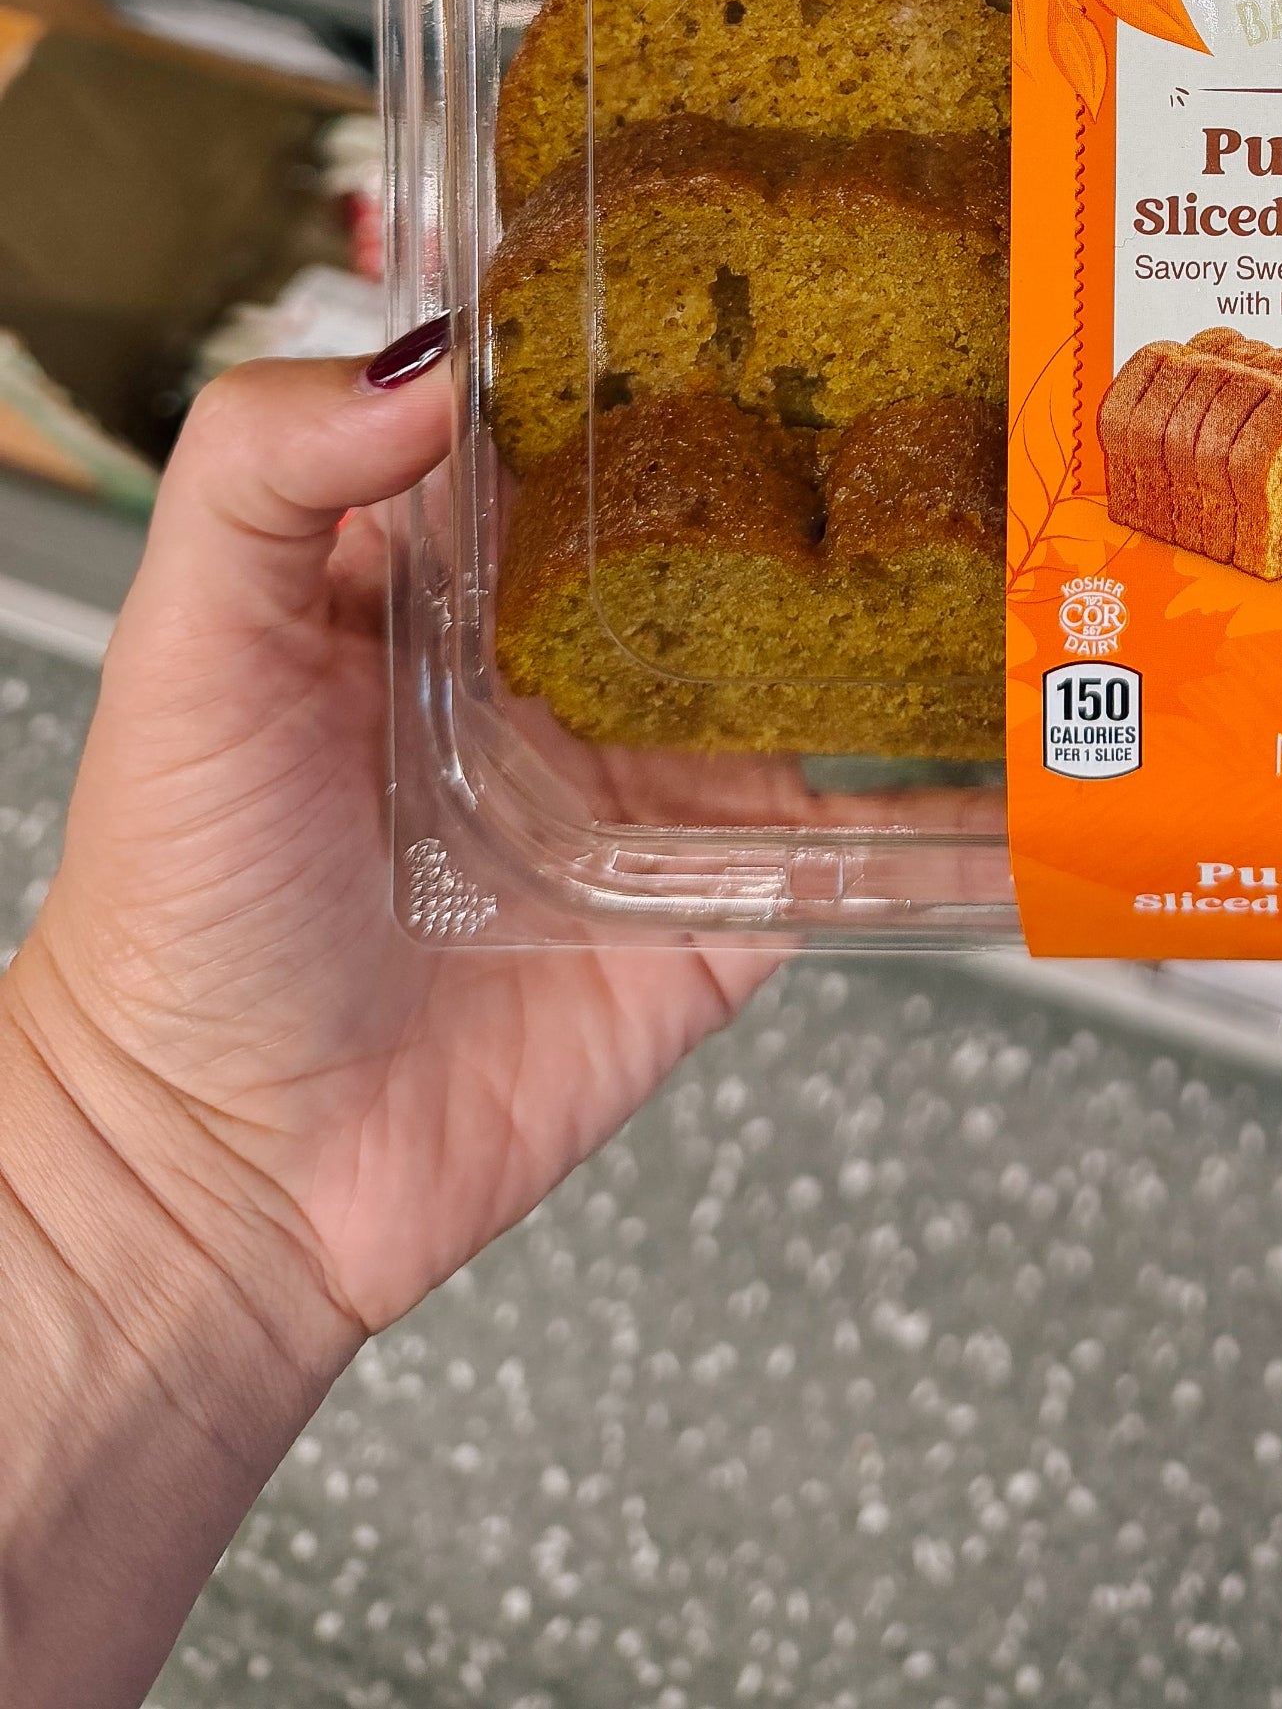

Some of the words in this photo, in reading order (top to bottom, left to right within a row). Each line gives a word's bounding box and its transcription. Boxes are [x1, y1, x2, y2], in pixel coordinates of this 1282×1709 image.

[1134, 254, 1228, 286] Savory
[1217, 291, 1270, 316] with
[1060, 576, 1125, 597] KOSHER
[1062, 603, 1122, 628] COR
[1063, 635, 1119, 655] DAIRY
[1056, 677, 1130, 722] 150
[1050, 725, 1136, 744] CALORIES
[1054, 748, 1080, 761] PER
[1084, 748, 1090, 761] 1
[1095, 748, 1132, 761] SLICE
[1133, 892, 1279, 914] Sliced
